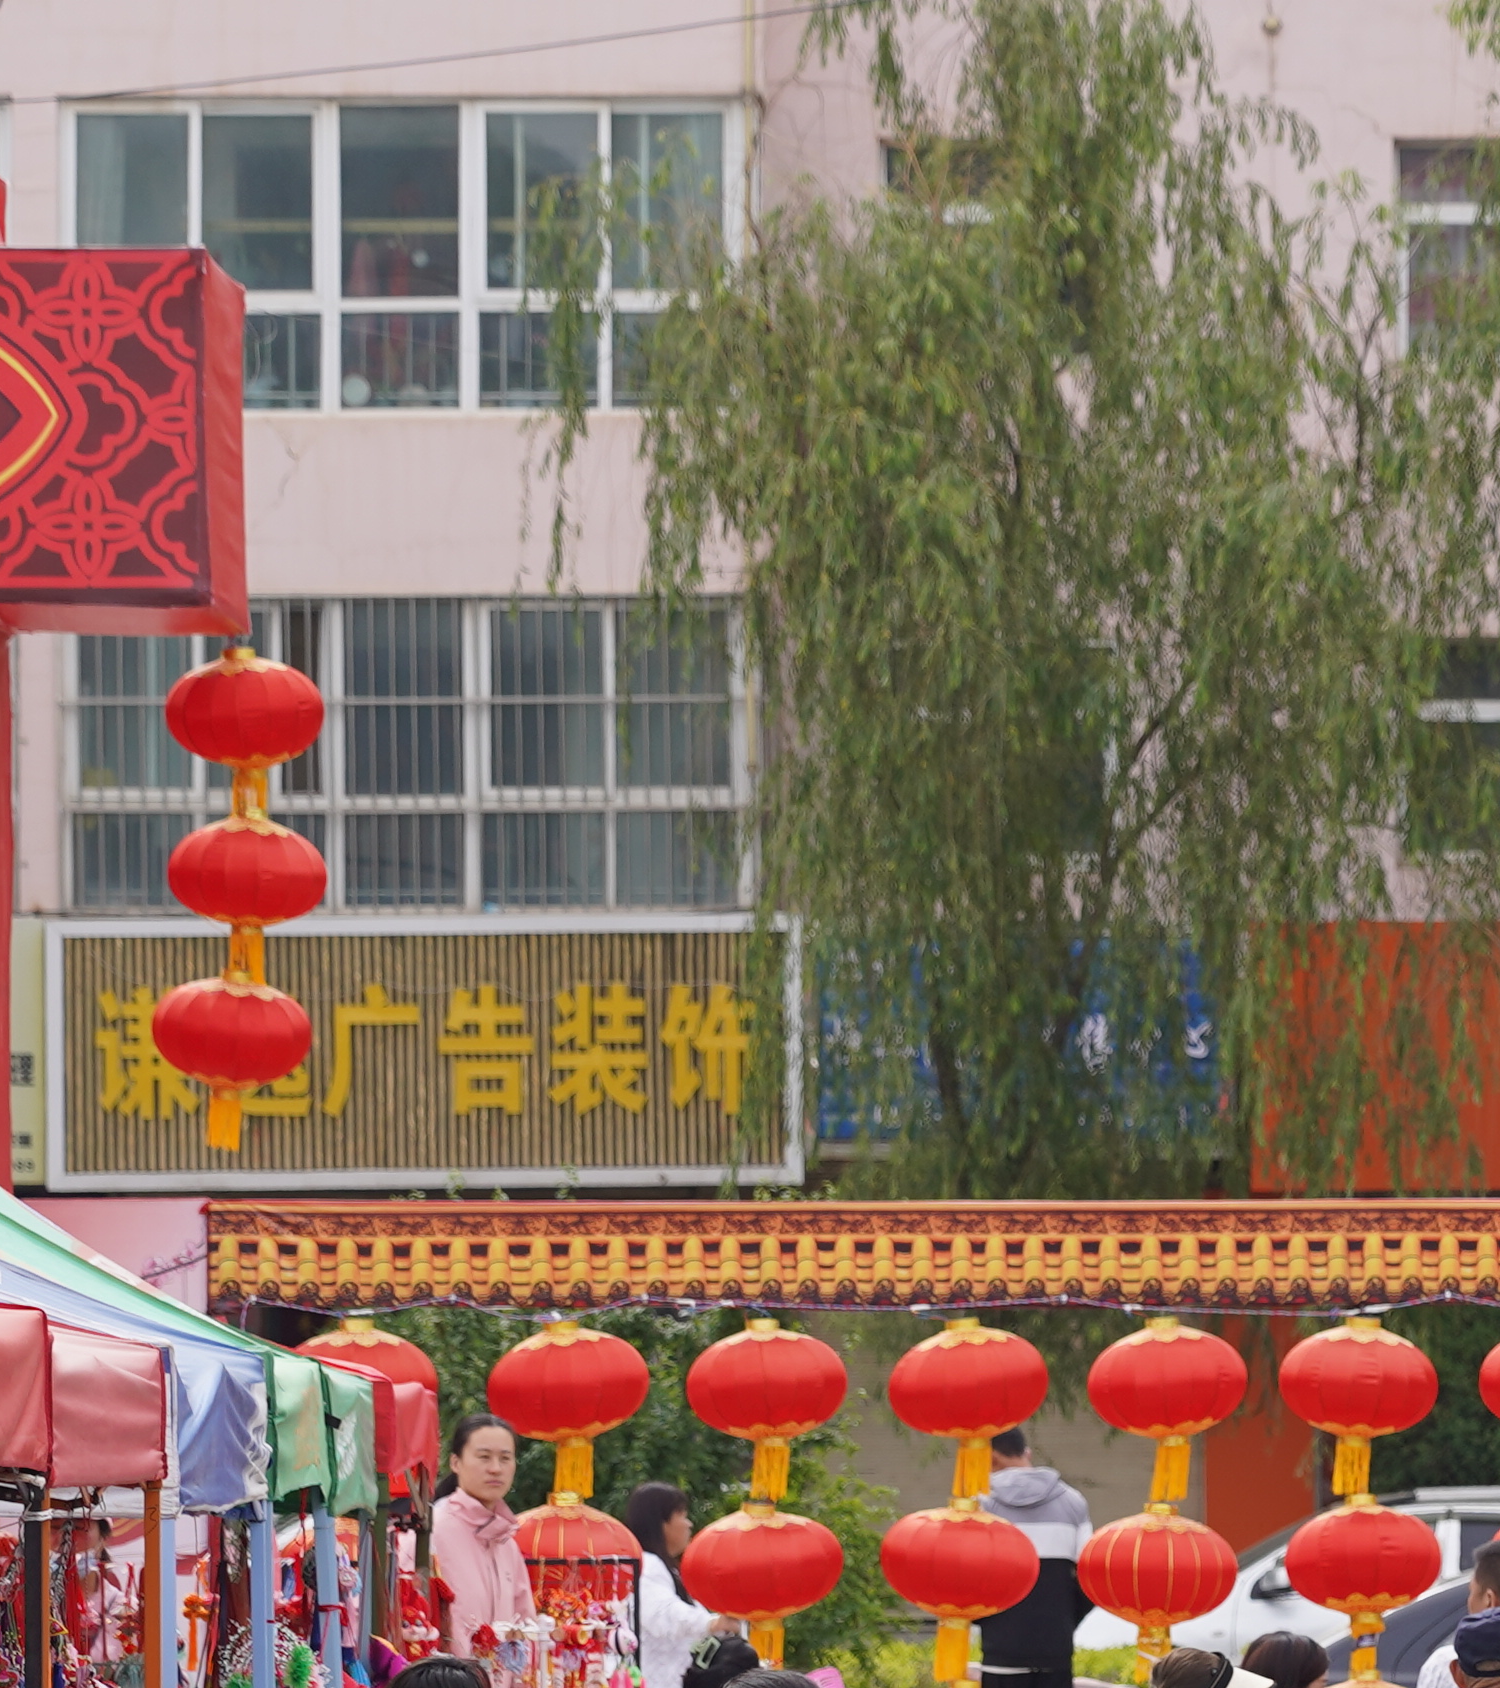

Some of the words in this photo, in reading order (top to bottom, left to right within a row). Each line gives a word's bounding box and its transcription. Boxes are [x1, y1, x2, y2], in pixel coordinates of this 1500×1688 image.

[94, 984, 750, 1121] 谦广告装饰
